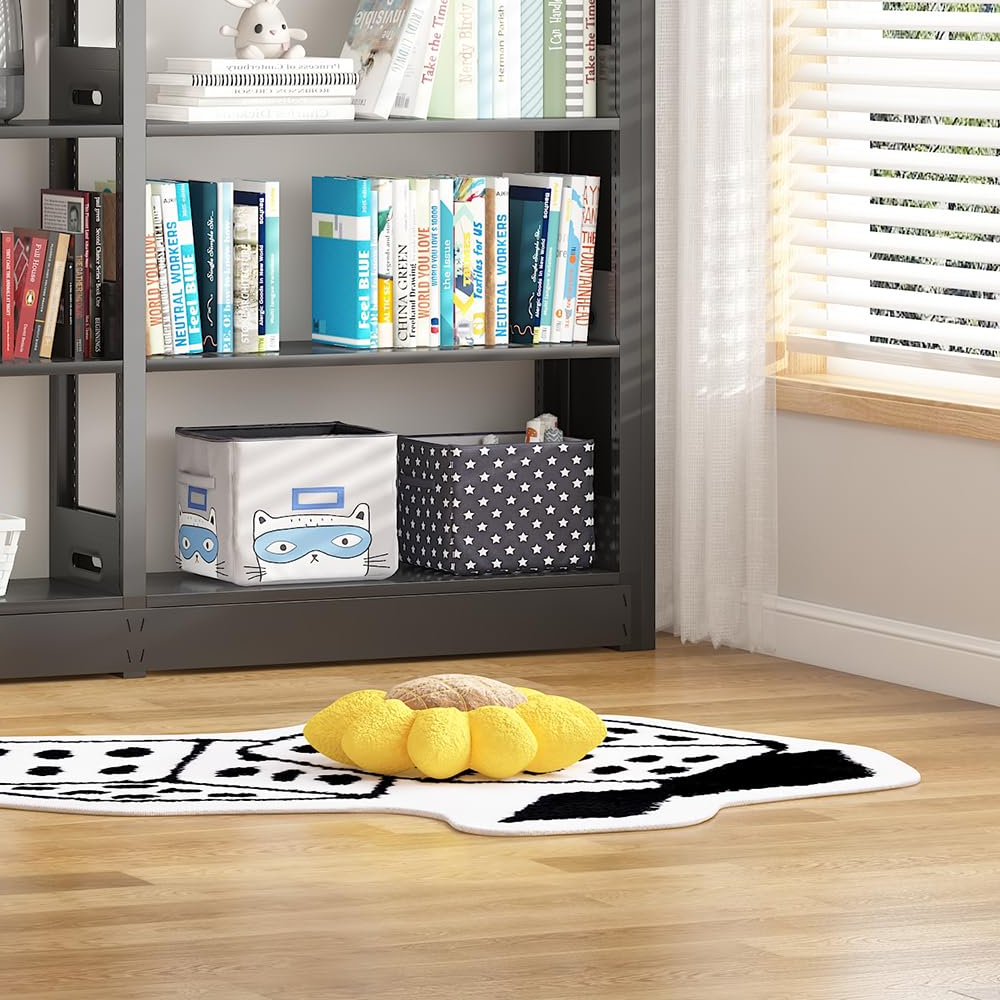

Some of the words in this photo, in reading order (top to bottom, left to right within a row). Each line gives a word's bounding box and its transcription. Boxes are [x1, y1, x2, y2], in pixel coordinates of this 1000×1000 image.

[355, 8, 406, 26] Invisible
[550, 28, 562, 44] Can
[586, 34, 595, 54] the
[422, 57, 436, 84] Take
[430, 32, 441, 55] the
[459, 44, 474, 84] Nerdy
[586, 56, 595, 84] Take
[418, 227, 430, 254] LOVE
[473, 222, 482, 236] US
[497, 214, 507, 275] WORKERS
[33, 244, 42, 258] Full
[145, 234, 156, 260] LOVE
[166, 221, 181, 284] WORKERS
[473, 239, 483, 255] for
[30, 259, 40, 282] House
[146, 262, 158, 285] YOU
[183, 254, 197, 294] BLUE
[358, 250, 370, 289] BLUE
[398, 244, 407, 290] GREEN
[418, 256, 430, 278] YOU
[473, 260, 483, 299] Textiles
[418, 281, 430, 318] WORLD
[575, 245, 595, 326] FOUNTAINHEAD
[148, 288, 162, 326] WORLD
[172, 289, 187, 346] NEUTRAL
[187, 300, 200, 334] Feel
[358, 296, 370, 328] Feel
[398, 295, 408, 341] CHINA
[496, 281, 507, 336] NEUTRAL
